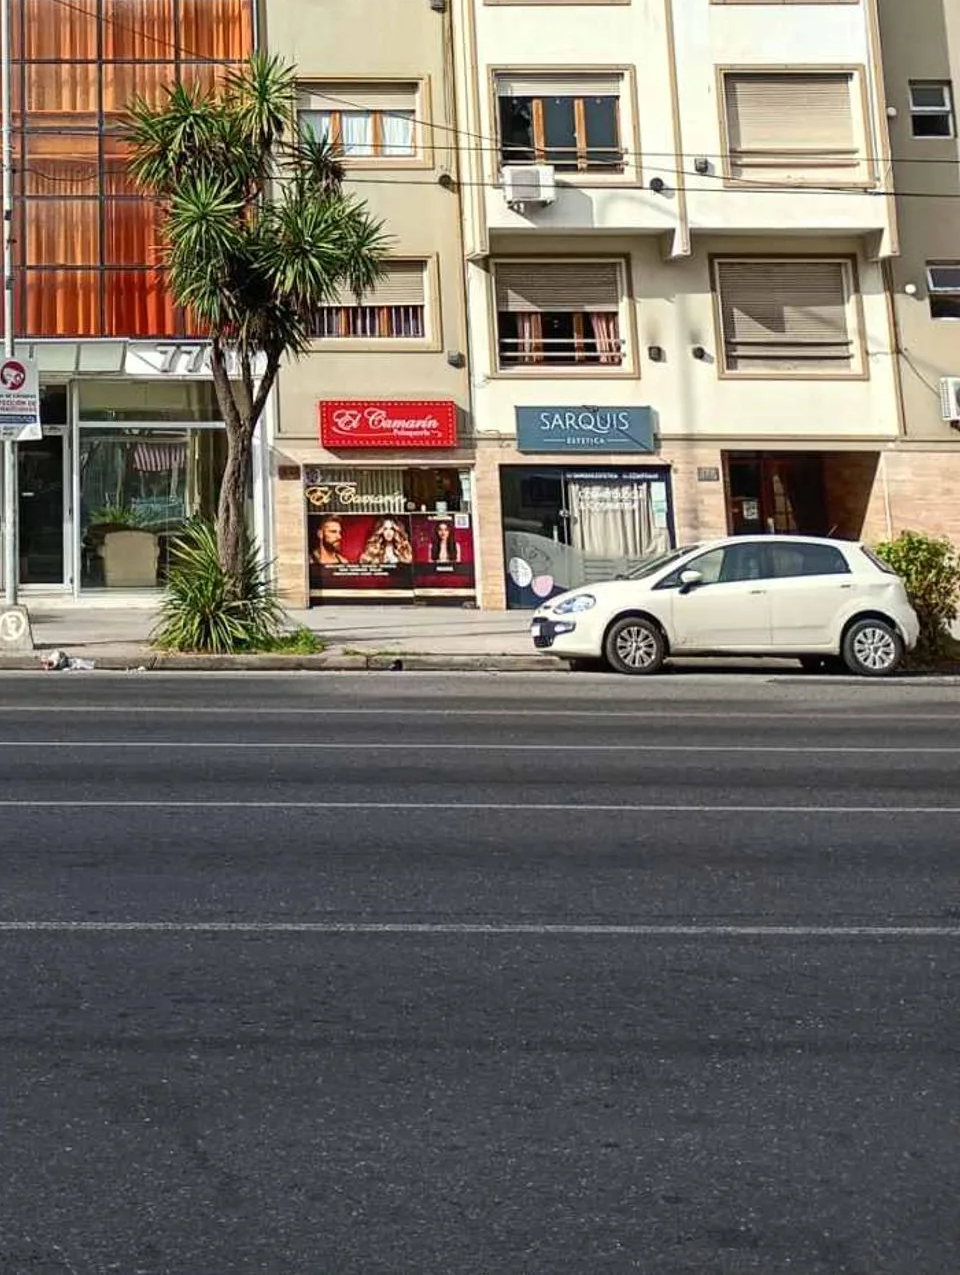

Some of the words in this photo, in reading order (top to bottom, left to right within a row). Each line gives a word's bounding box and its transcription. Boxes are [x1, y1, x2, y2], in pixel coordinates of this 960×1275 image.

[333, 409, 361, 431] El
[364, 407, 439, 430] Camarín
[540, 412, 629, 434] SARQUIS
